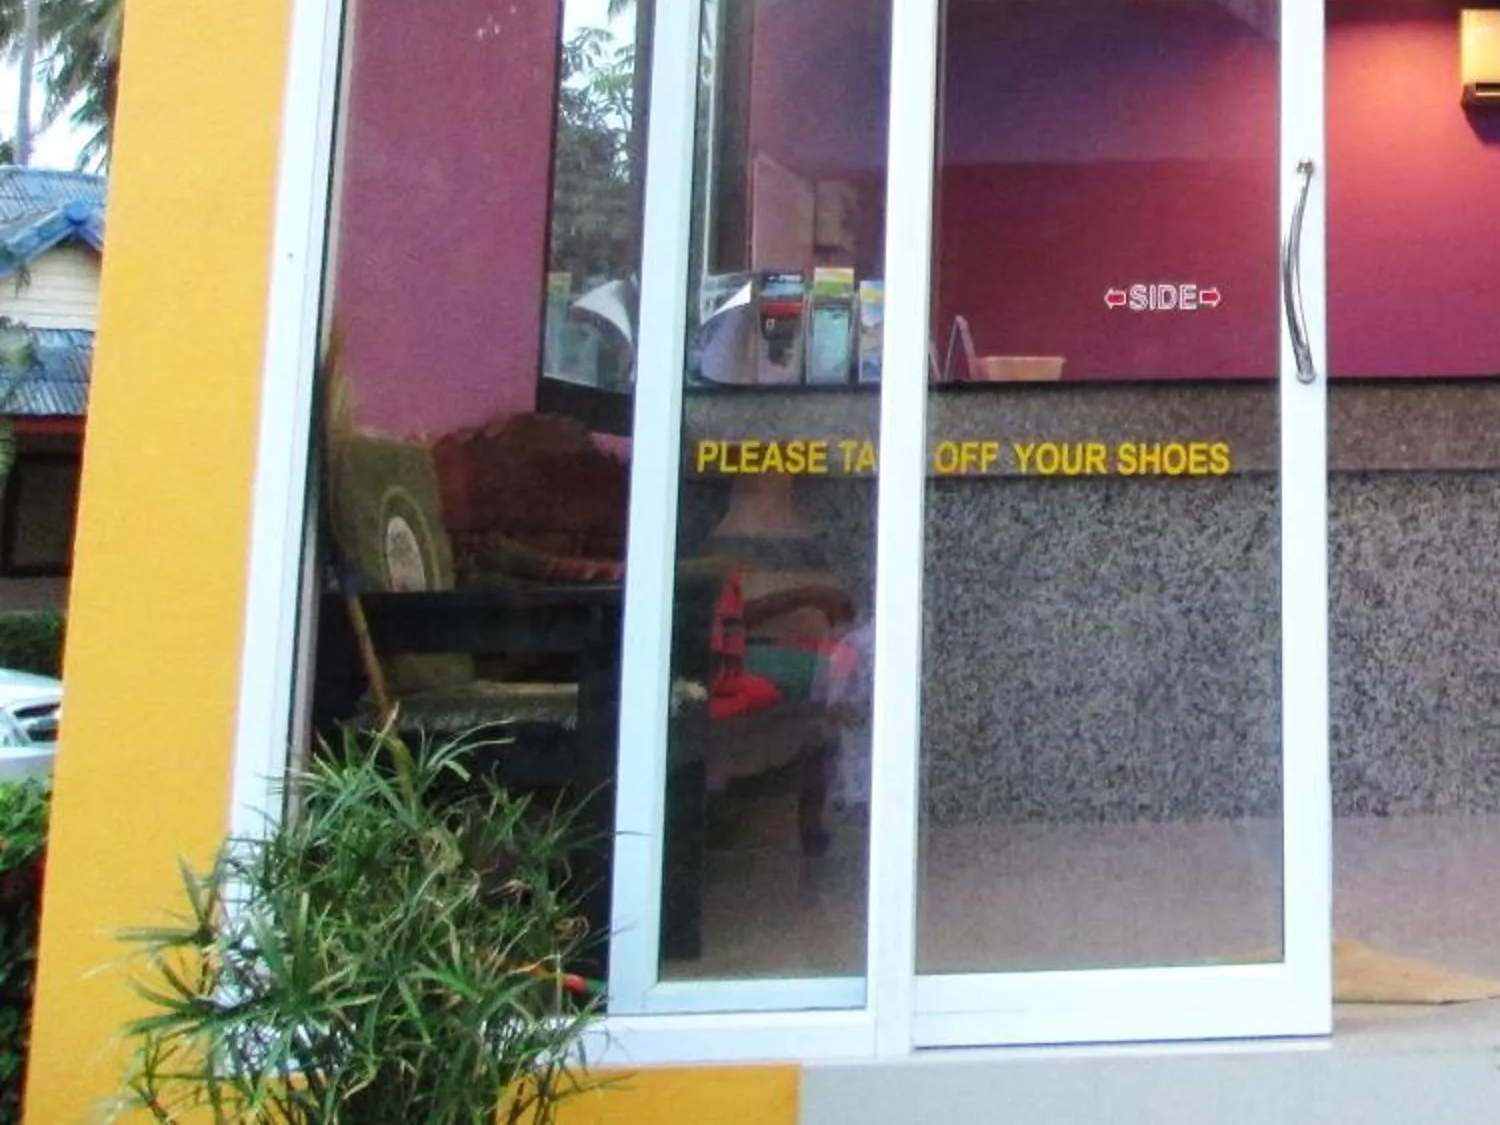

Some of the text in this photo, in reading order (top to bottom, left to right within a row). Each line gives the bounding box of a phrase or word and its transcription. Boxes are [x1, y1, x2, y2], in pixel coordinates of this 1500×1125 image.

[1127, 283, 1200, 312] SIDE
[697, 440, 1232, 476] PLEASE TA OFF YOUR SHOES
